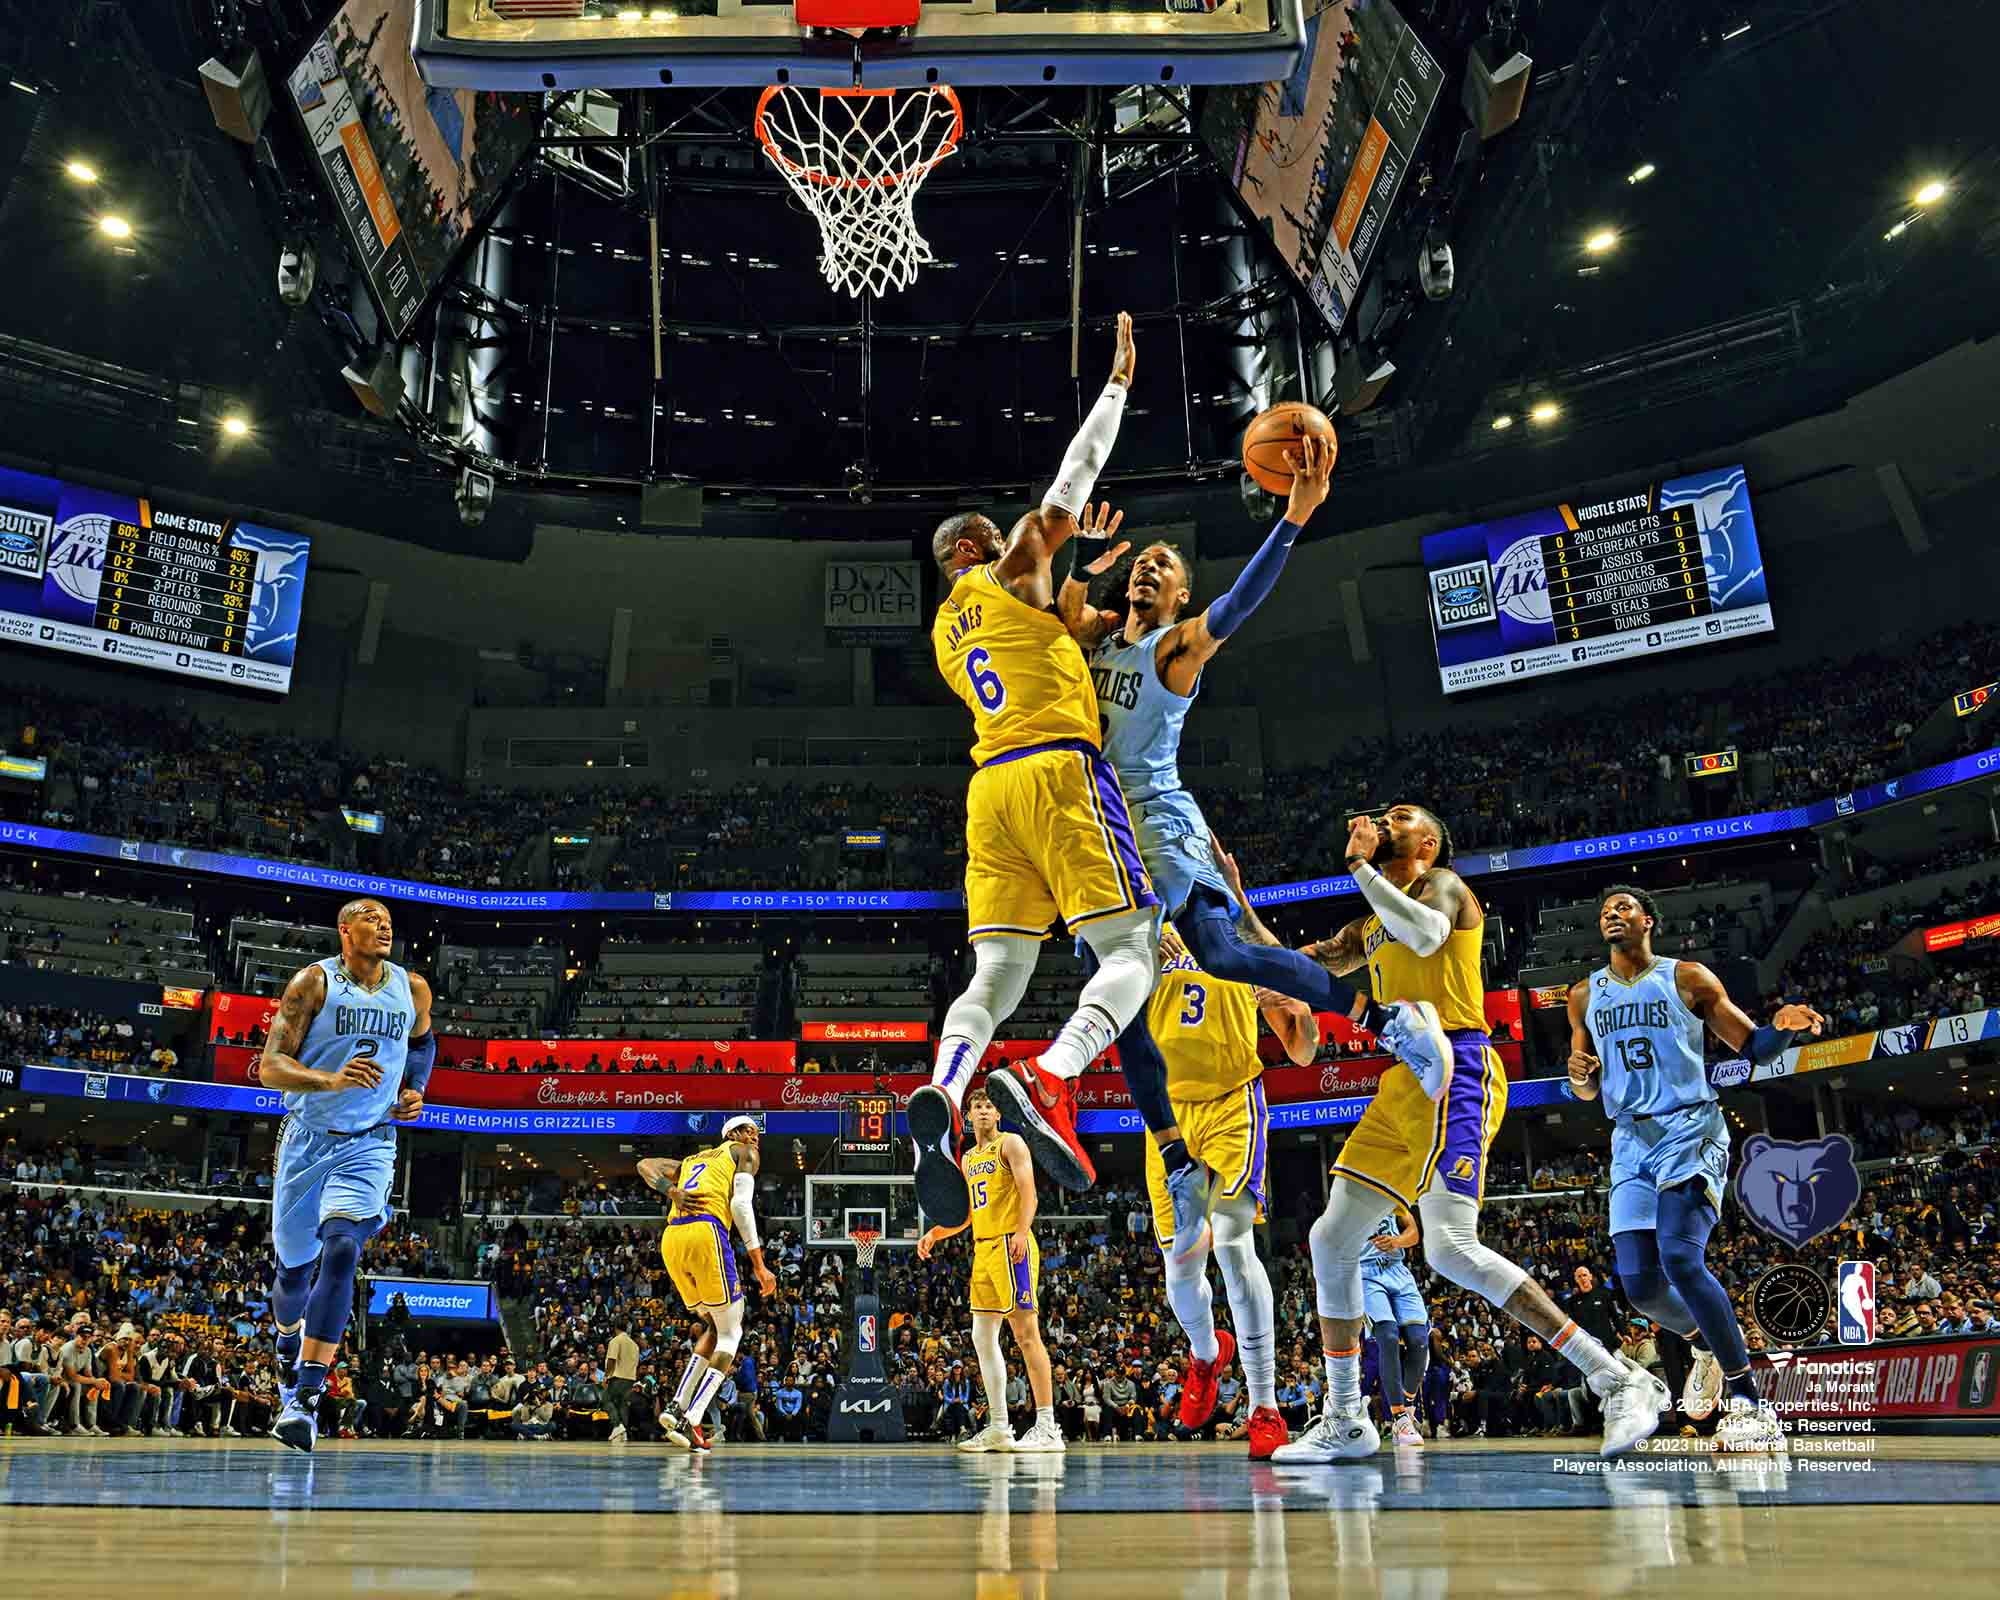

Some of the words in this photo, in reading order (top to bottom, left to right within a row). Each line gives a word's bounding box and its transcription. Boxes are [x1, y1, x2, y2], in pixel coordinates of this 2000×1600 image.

[336, 92, 353, 123] 13
[1388, 77, 1417, 129] 7:00
[316, 116, 335, 147] 13
[1578, 502, 1616, 521] HUSTLE
[1617, 494, 1648, 510] STATS
[154, 511, 186, 530] GAME
[187, 519, 222, 537] STATS
[1555, 536, 1564, 549] 0
[1574, 530, 1595, 545] 2ND
[1596, 520, 1638, 540] CHANCE
[1640, 515, 1660, 530] PTS
[1673, 511, 1680, 522] 4
[78, 535, 104, 545] LOS
[118, 524, 140, 539] 60%
[149, 531, 176, 547] FIELD
[178, 537, 210, 554] GOALS
[211, 545, 220, 557] %
[229, 550, 250, 563] 45%
[1558, 552, 1566, 564] 2
[1580, 538, 1638, 559] FASTBREAK
[1639, 532, 1659, 546] PTS
[1675, 526, 1683, 539] 0
[0, 550, 38, 570] OUGH
[120, 541, 136, 554] 1-2
[148, 546, 172, 562] FREE
[175, 552, 217, 572] THROWS
[229, 564, 247, 578] 2-2
[1516, 559, 1538, 569] LOS
[1561, 567, 1569, 578] 6
[1602, 551, 1643, 570] ASSISTS
[1678, 542, 1685, 554] 3
[113, 555, 134, 570] 0-2
[161, 565, 183, 581] 3-PT
[185, 571, 199, 583] FG
[229, 580, 245, 593] 1-3
[1437, 568, 1482, 591] BUILT
[1565, 582, 1570, 593] 1
[1594, 564, 1655, 587] TURNOVERS
[1681, 557, 1688, 569] 2
[113, 571, 129, 585] 0%
[153, 579, 176, 594] 3-PT
[177, 585, 191, 598] FG
[192, 588, 201, 599] %
[223, 594, 244, 608] 33%
[830, 593, 916, 614] POIER
[1451, 591, 1473, 602] Ford
[1567, 596, 1574, 609] 4
[1586, 592, 1602, 605] PTS
[1604, 587, 1618, 600] OFF
[1620, 577, 1669, 597] TURNOVERS
[1684, 572, 1691, 584] 0
[1611, 597, 1649, 615] STEALS
[1686, 588, 1694, 600] 0
[114, 587, 123, 599] 4
[147, 594, 202, 616] REBOUNDS
[227, 610, 235, 622] 5
[1442, 602, 1488, 622] TOUGH
[111, 603, 120, 615] 2
[152, 611, 193, 630] BLOCKS
[225, 626, 233, 638] 0
[945, 603, 983, 652] JAMES
[1572, 628, 1579, 639] 3
[1615, 613, 1650, 631] DUNKS
[108, 618, 119, 631] 10
[130, 622, 167, 640] POINTS
[168, 630, 179, 642] IN
[180, 633, 209, 649] PAINT
[222, 640, 230, 653] 6
[965, 646, 1007, 714] 6
[1449, 670, 1506, 686] GRIZZLIES.COM
[1574, 840, 1621, 856] FORD
[1691, 820, 1753, 839] TRUCK
[257, 864, 318, 882] OFFICIAL
[321, 874, 365, 889] TRUCK
[369, 881, 386, 891] OF
[390, 883, 414, 896] THE
[418, 888, 477, 904] MEMPHIS
[481, 896, 547, 906] GRIZZLIES
[1249, 886, 1308, 903] MEMPHIS
[732, 896, 774, 905] FORD
[837, 896, 890, 905] TRUCK
[1374, 963, 1383, 995] 1
[1181, 983, 1208, 1027] 3
[336, 1005, 406, 1040] GRIZZLIES
[864, 1029, 906, 1038] FanDeck
[1594, 1000, 1669, 1039] GRIZZLIES
[1949, 1017, 1969, 1043] 13
[352, 1039, 379, 1059] 2
[1616, 1036, 1655, 1073] 13
[1714, 1064, 1750, 1082] LAKERS
[1770, 1056, 1785, 1075] 13
[615, 1091, 684, 1105] FanDeck
[858, 1100, 887, 1114] 7:00
[421, 1111, 450, 1124] THE
[454, 1114, 529, 1128] MEMPHIS
[534, 1117, 616, 1128] GRIZZLIES
[861, 1115, 882, 1139] 19
[1280, 1109, 1311, 1122] THE
[857, 1143, 890, 1151] TISSOT
[684, 1163, 706, 1190] 2
[971, 1181, 987, 1210] 15
[1885, 1354, 1919, 1405] NBA
[1919, 1353, 1959, 1404] APP
